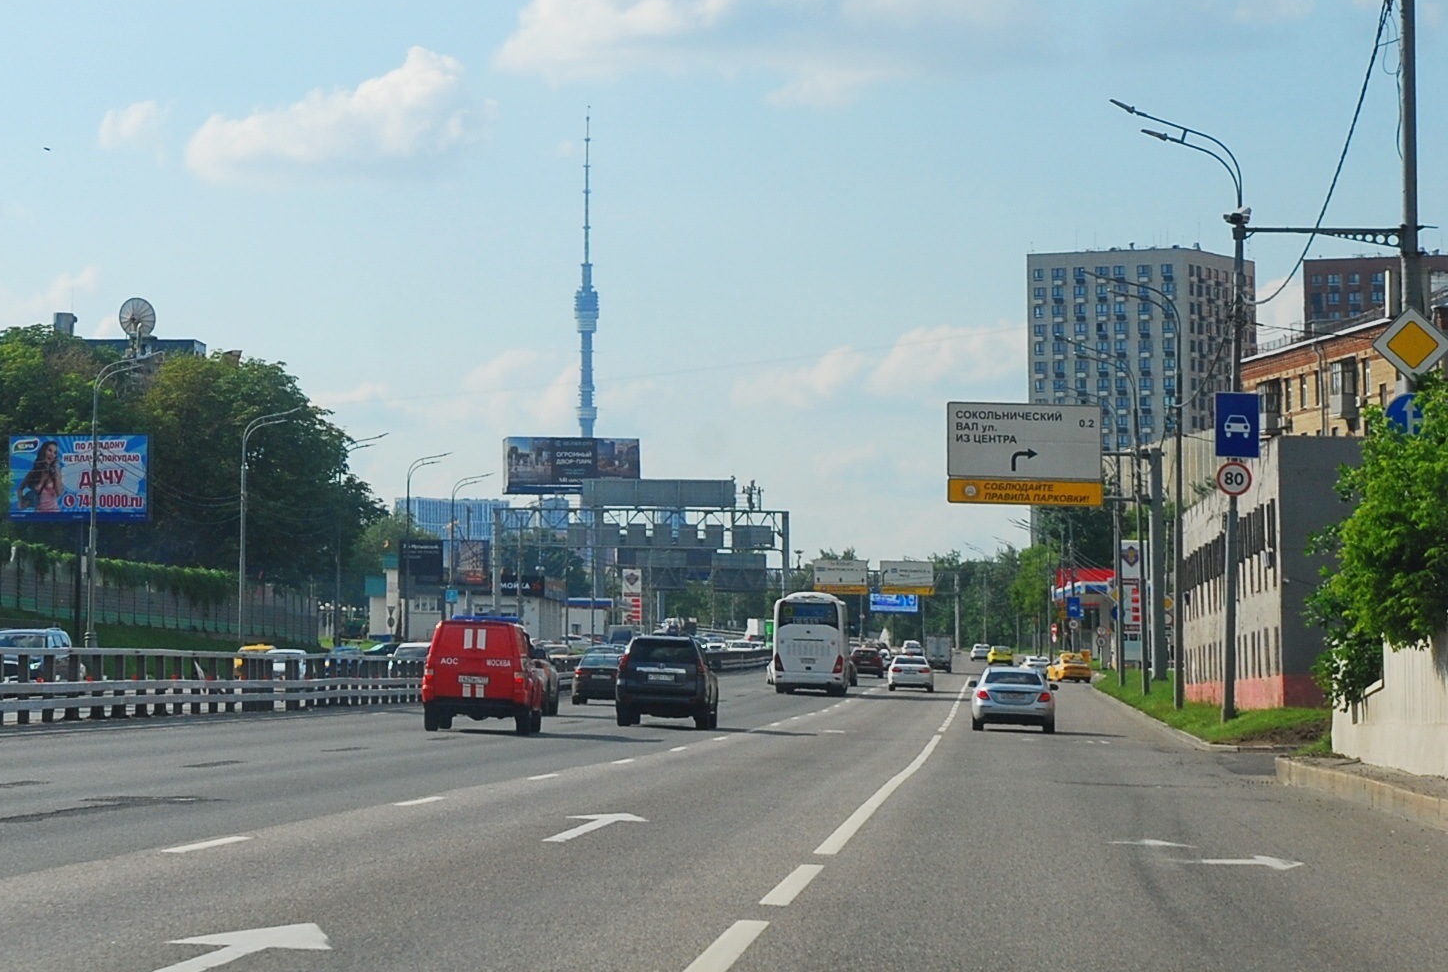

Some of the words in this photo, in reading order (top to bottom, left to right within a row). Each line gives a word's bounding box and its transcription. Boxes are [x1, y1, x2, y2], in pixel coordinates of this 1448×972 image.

[955, 410, 1062, 421] СОКОЛЬНИЧЕСКИЙ
[955, 422, 979, 431] ВАЛ
[981, 424, 997, 432] ул.
[1078, 419, 1094, 428] 0.2
[955, 434, 970, 443] ИЗ
[973, 435, 1017, 444] ЦЕНТРА
[75, 442, 85, 450] ПО
[63, 455, 72, 463] НЕ
[556, 450, 592, 458] ОГРОМНЫЙ
[78, 469, 124, 489] ДАЧУ
[1224, 471, 1244, 486] 80
[984, 483, 1054, 492] СОБЛЮДАЙТЕ
[984, 492, 1031, 502] ПРАВИЛА
[1033, 494, 1090, 503] ПАРКОВКИ!
[440, 657, 459, 665] АОС
[486, 659, 511, 667] МОСКВА
